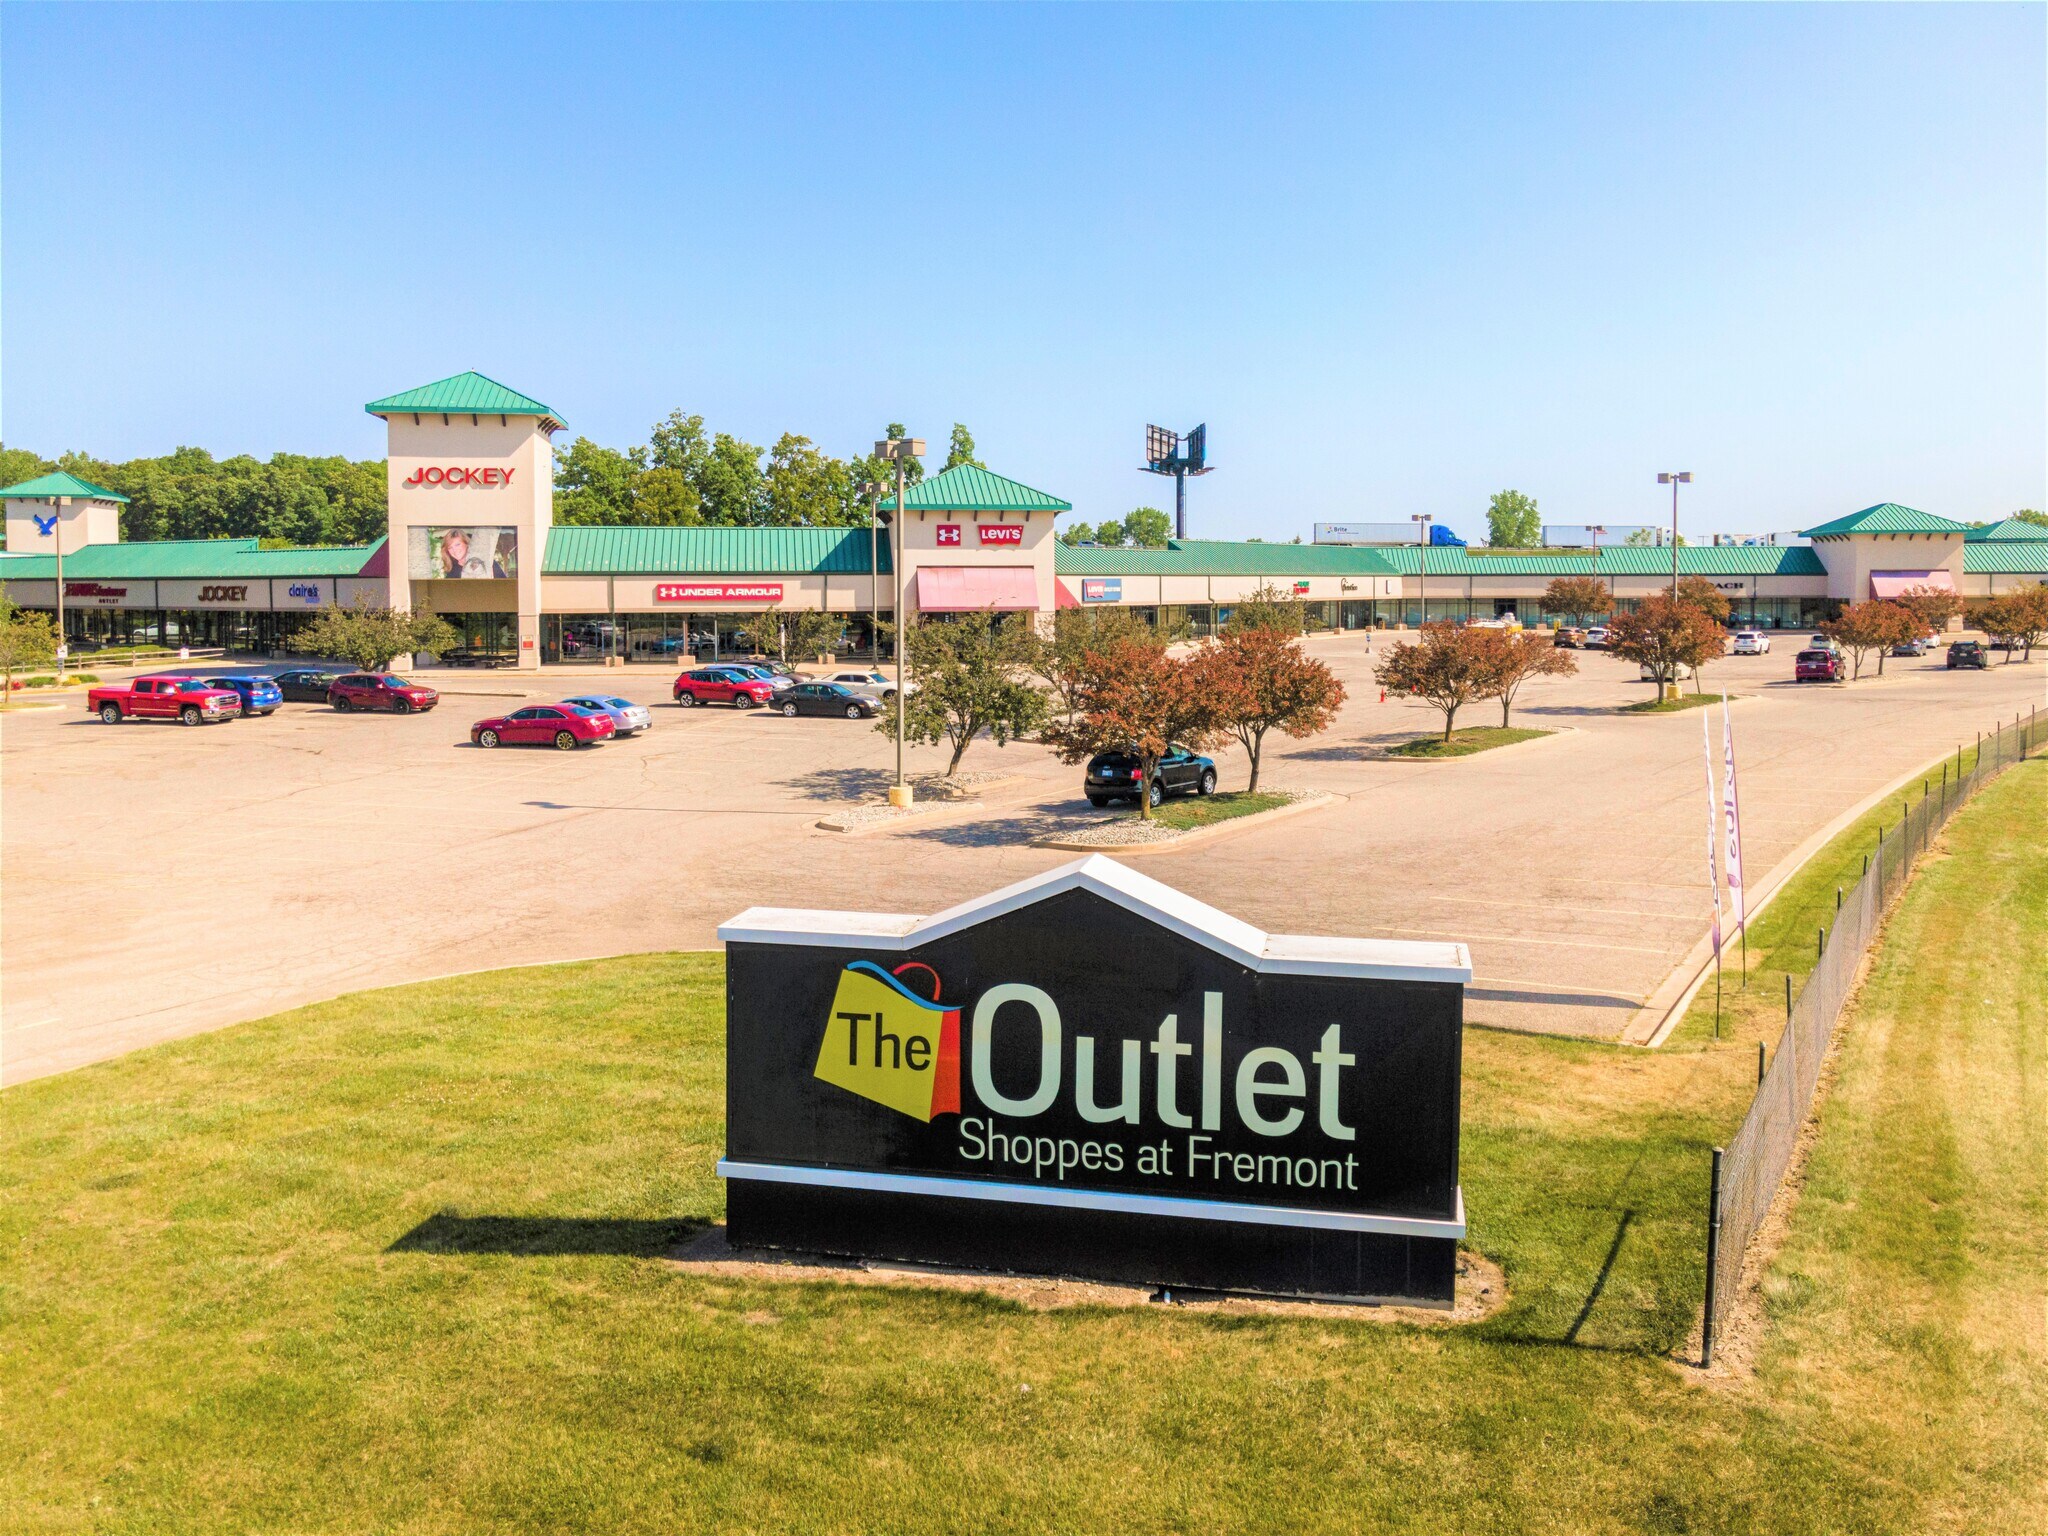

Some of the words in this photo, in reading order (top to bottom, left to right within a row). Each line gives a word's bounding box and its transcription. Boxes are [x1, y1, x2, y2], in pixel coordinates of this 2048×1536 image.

[407, 467, 515, 485] JOCKEY
[198, 586, 248, 601] JOCKEY
[288, 583, 319, 597] claire's
[679, 588, 723, 596] UNDER
[726, 588, 781, 596] ARMOUR
[836, 1012, 932, 1071] The
[971, 983, 1356, 1140] Outlet
[959, 1117, 1124, 1180] Shoppes
[1137, 1139, 1173, 1176] at
[1188, 1136, 1360, 1190] Fremont
